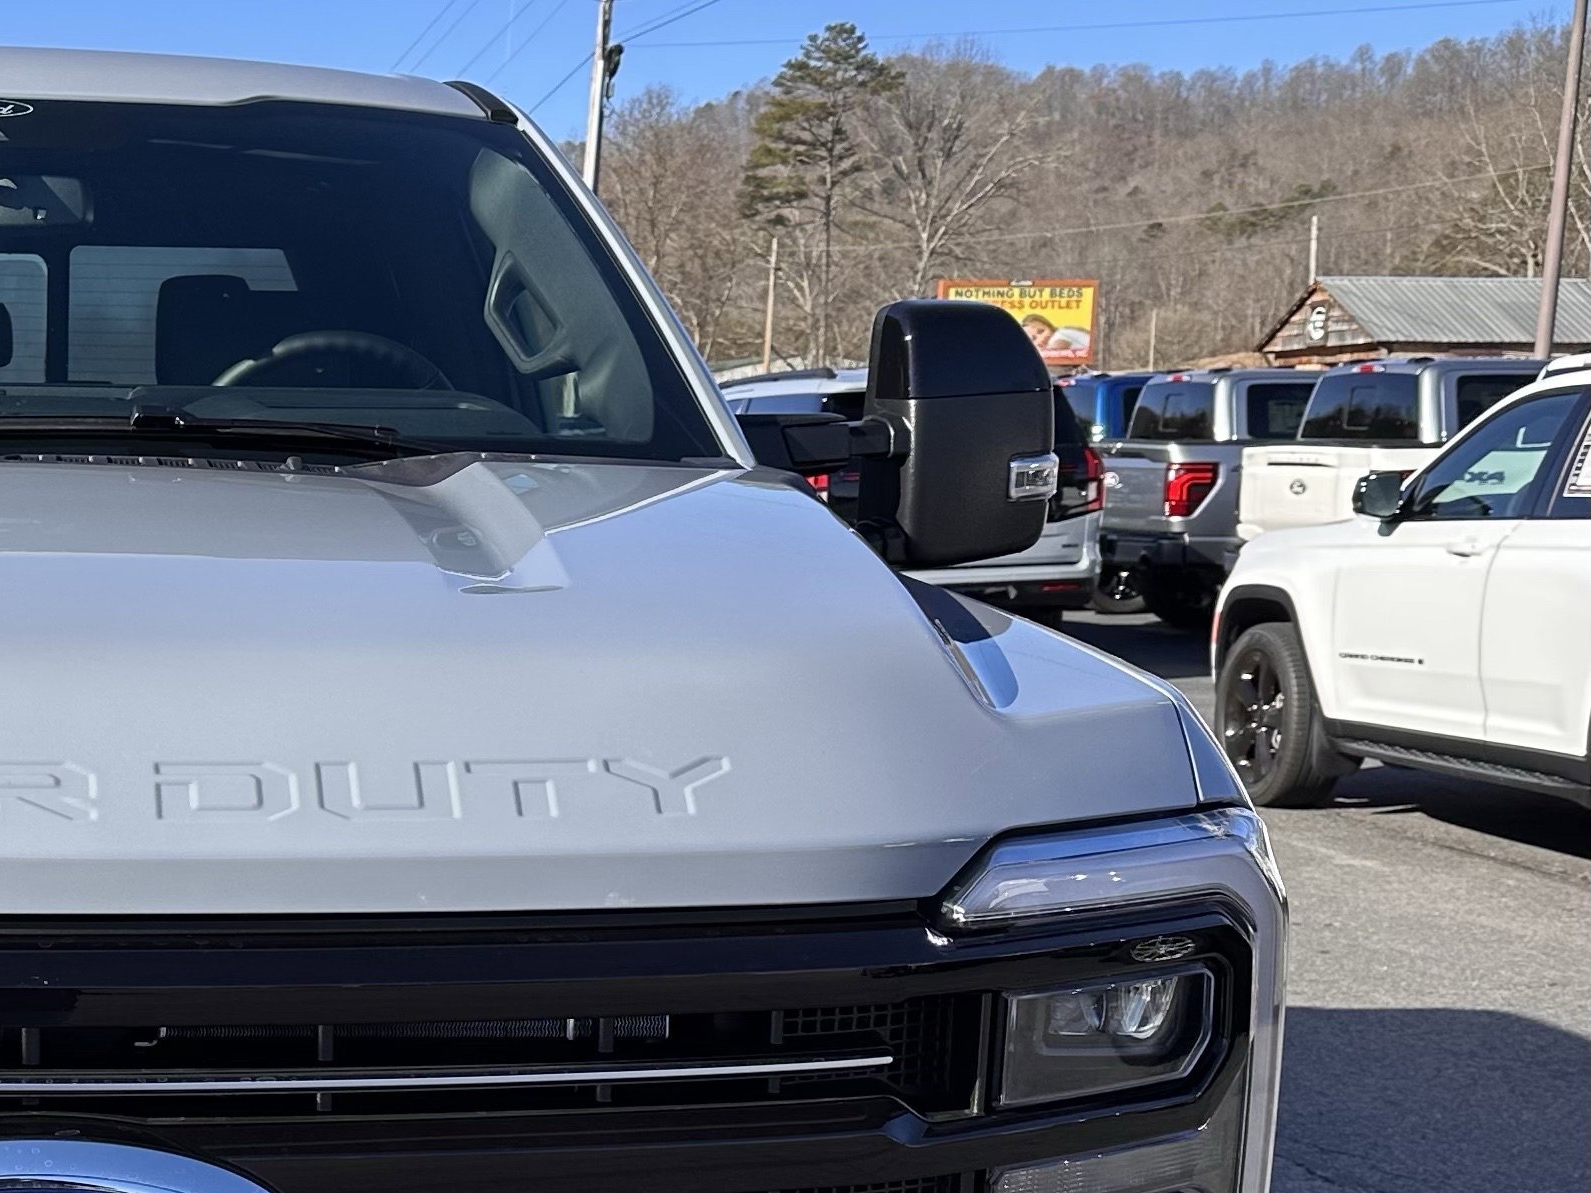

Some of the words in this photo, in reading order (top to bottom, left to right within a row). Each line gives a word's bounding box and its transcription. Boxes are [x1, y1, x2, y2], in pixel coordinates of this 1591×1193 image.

[953, 287, 1014, 299] NOTHING
[1019, 287, 1045, 299] BUT
[1049, 287, 1084, 299] BEDS
[1028, 299, 1083, 311] OUTLET
[153, 755, 733, 823] DUTY
